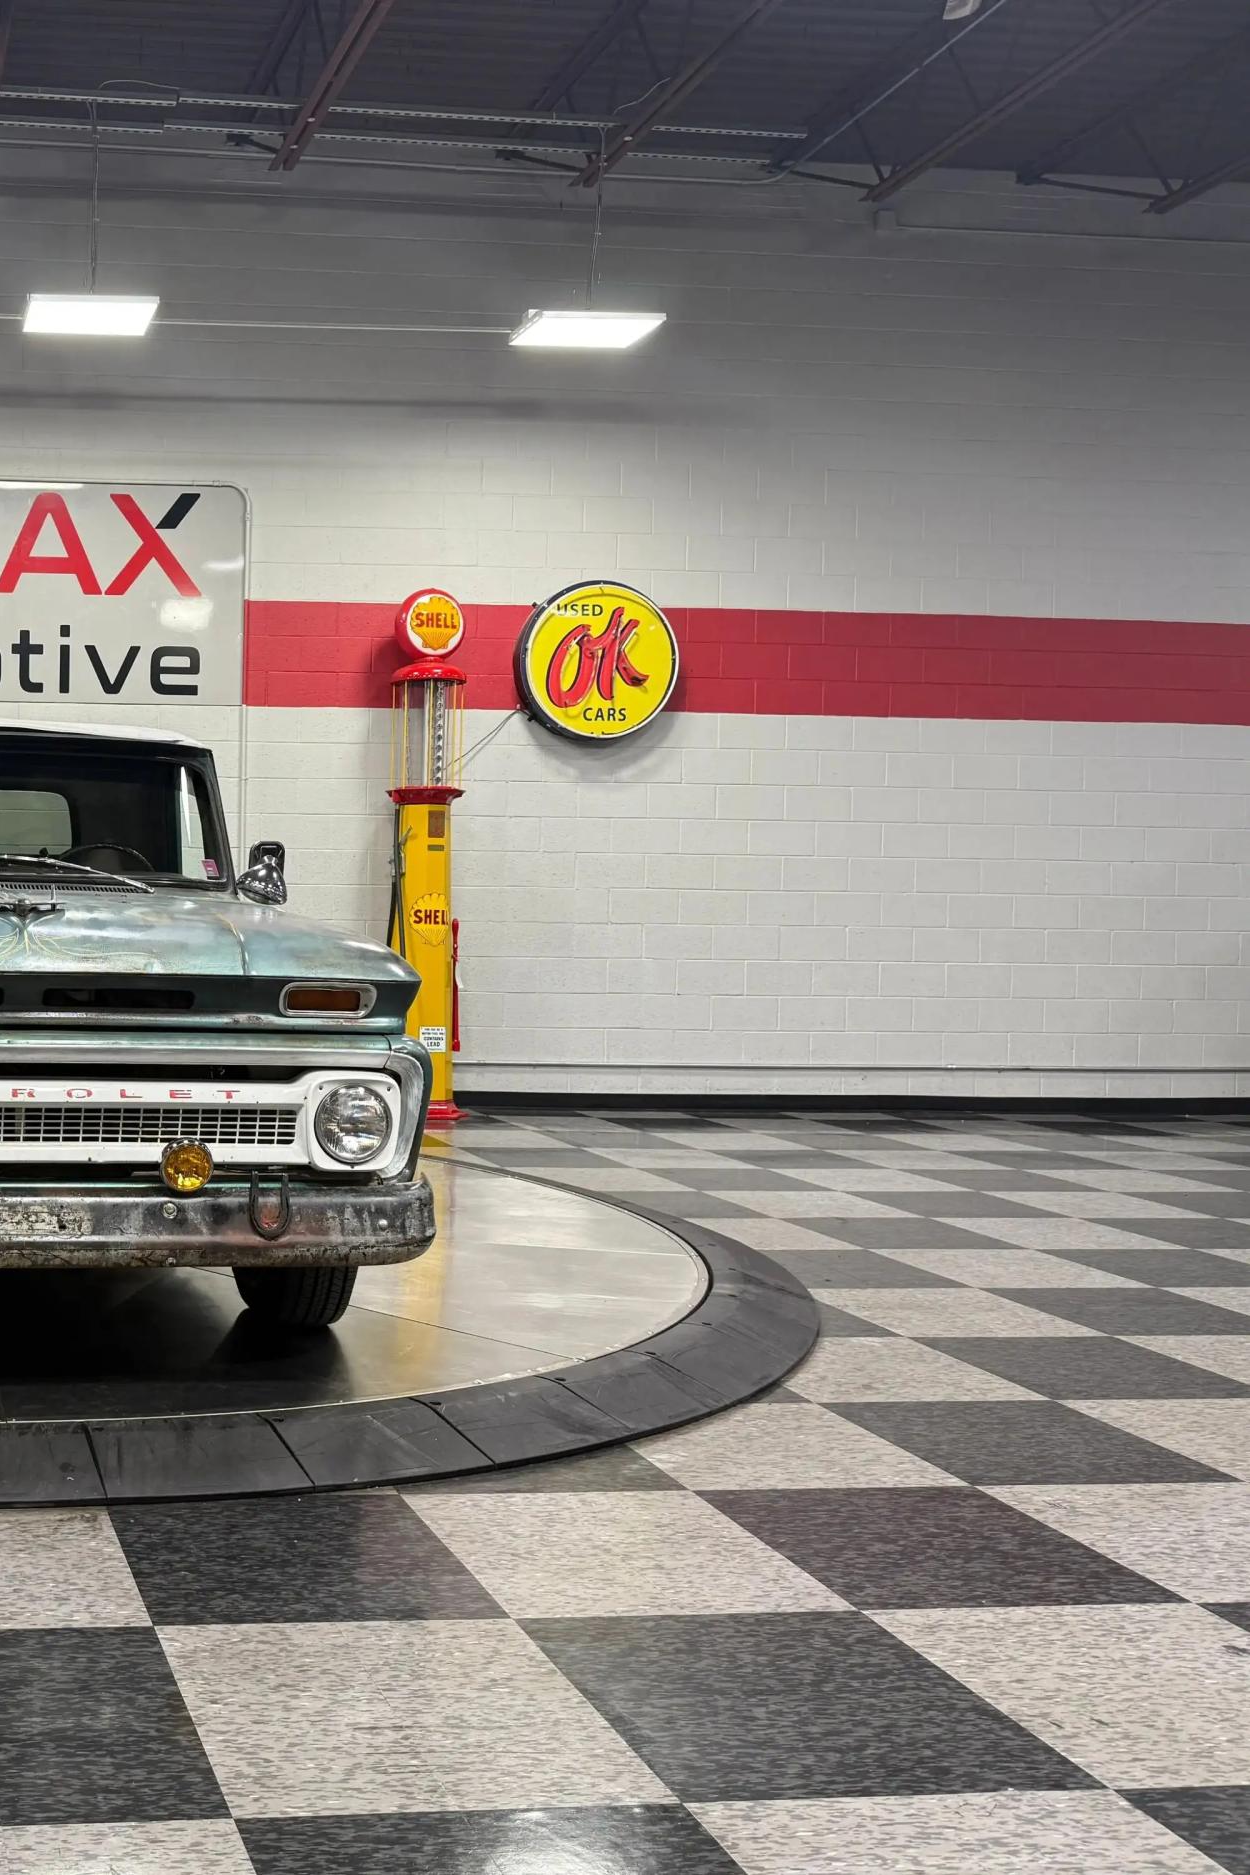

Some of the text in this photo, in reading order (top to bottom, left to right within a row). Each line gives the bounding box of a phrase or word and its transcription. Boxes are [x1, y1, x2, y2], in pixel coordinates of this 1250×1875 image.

[556, 603, 604, 617] USED
[414, 612, 457, 630] SHELL
[545, 606, 650, 709] OK
[582, 707, 627, 722] CARS
